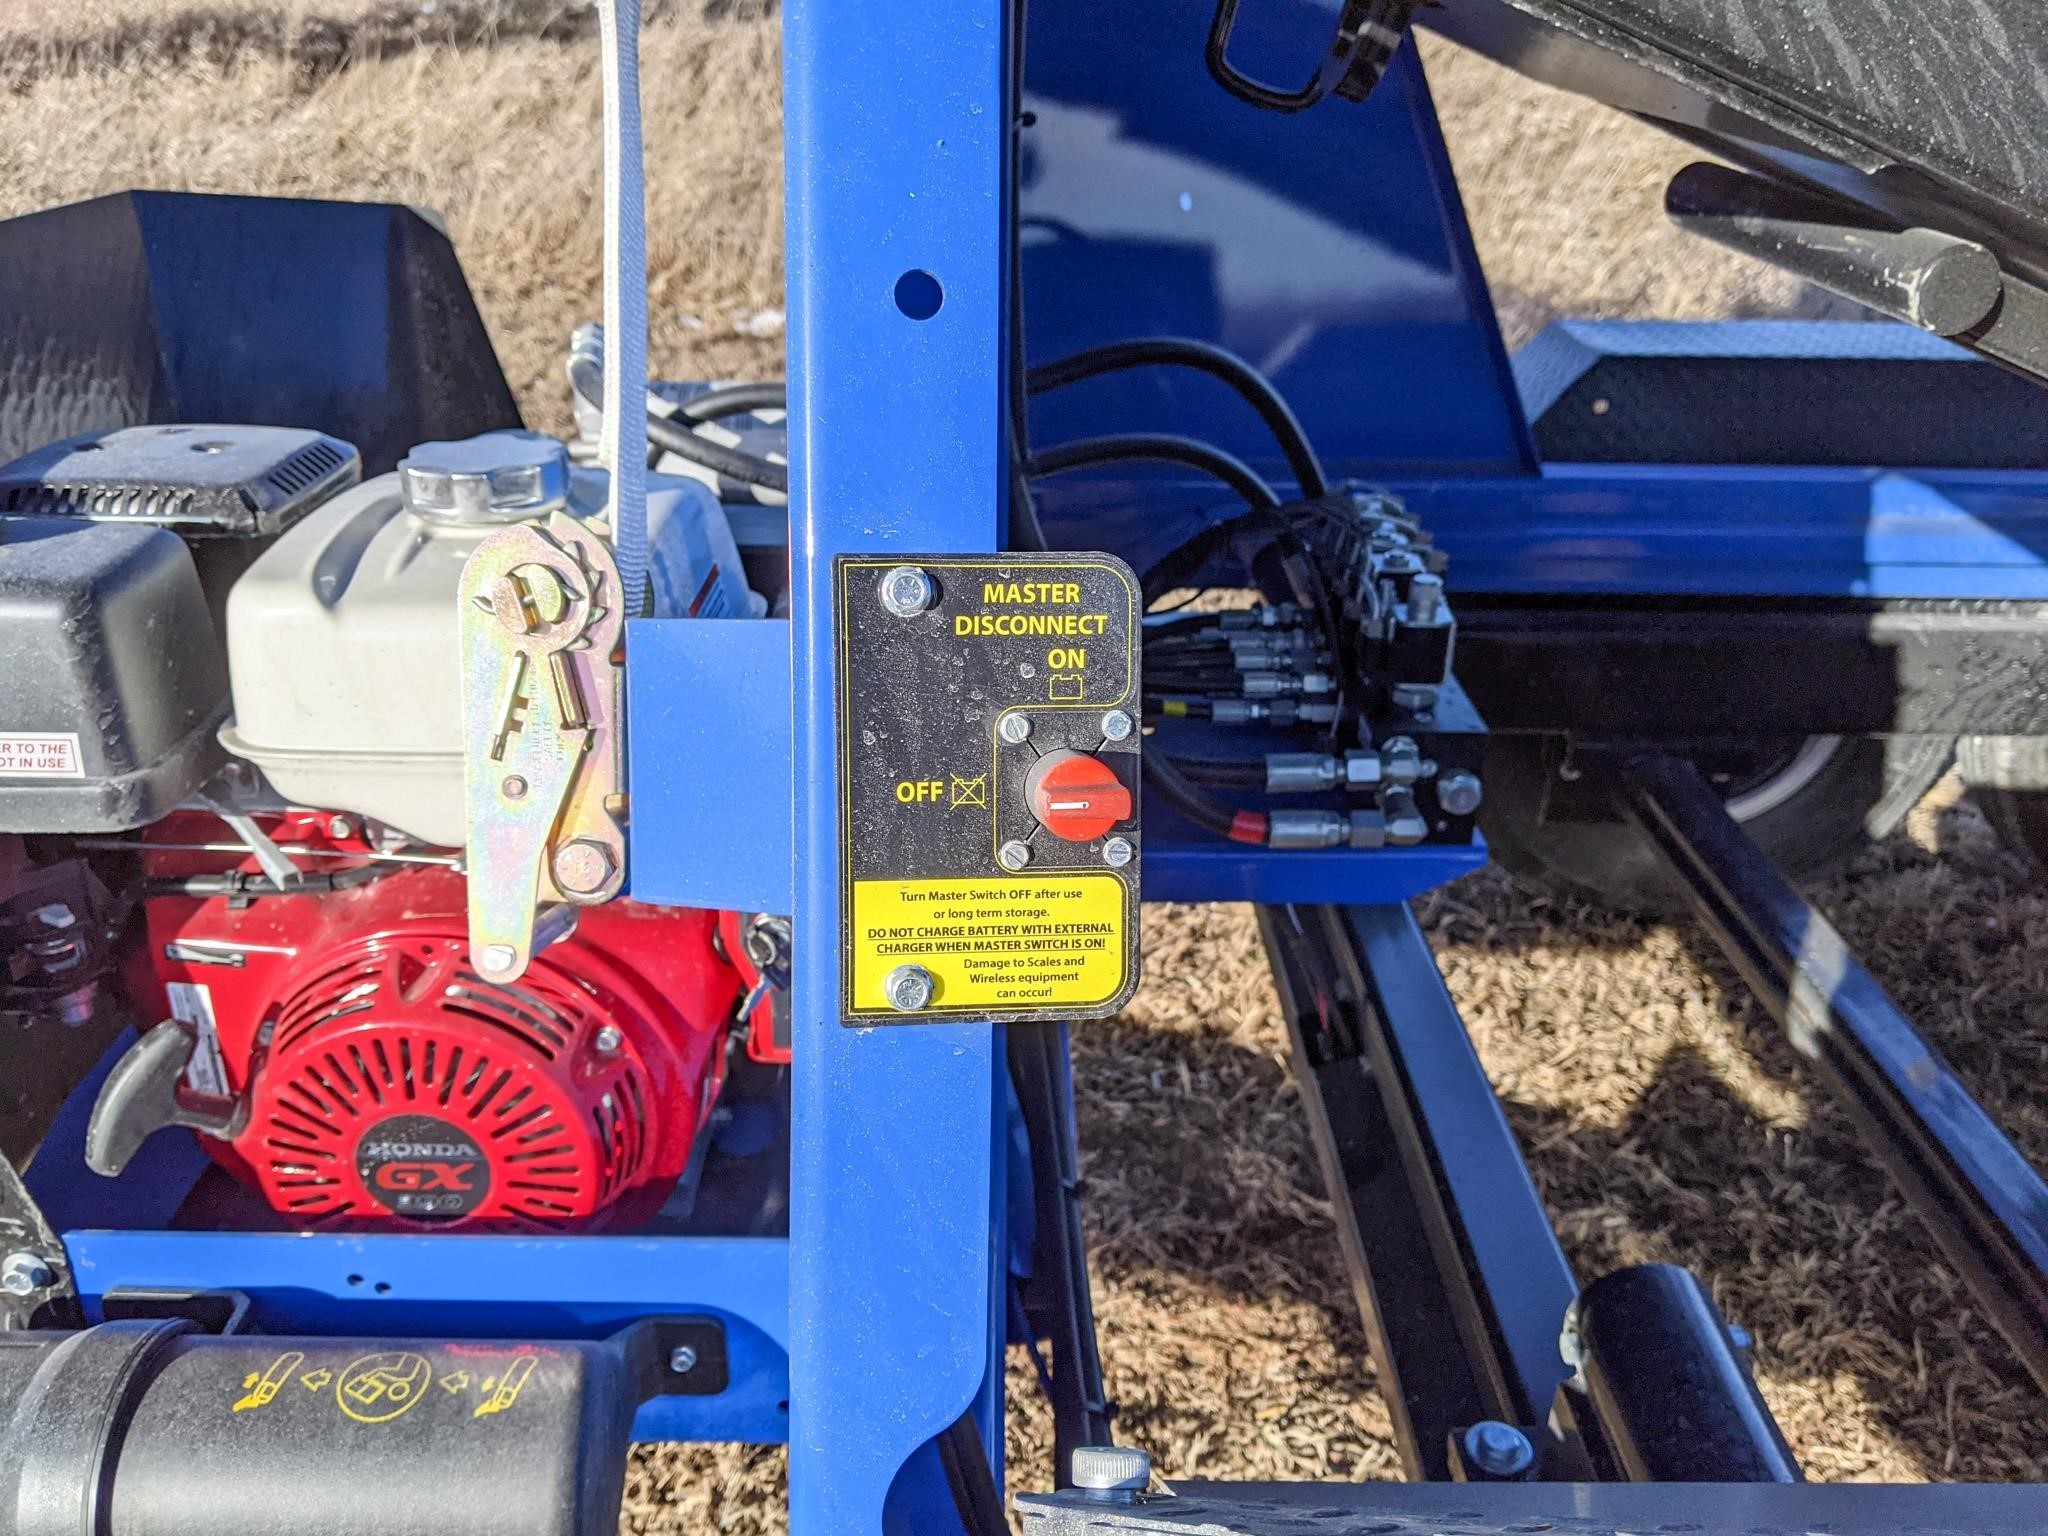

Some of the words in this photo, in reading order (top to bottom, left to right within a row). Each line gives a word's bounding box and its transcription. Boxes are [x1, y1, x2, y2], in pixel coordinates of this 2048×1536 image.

[983, 583, 1080, 604] MASTER
[955, 614, 1108, 636] DISCONNECT
[1048, 648, 1086, 670] ON
[16, 743, 35, 754] TO
[40, 743, 67, 754] THE
[20, 757, 33, 768] IN
[37, 758, 65, 768] USE
[896, 781, 944, 803] OFF
[900, 891, 926, 902] Turn
[928, 890, 967, 901] Master
[969, 889, 1006, 900] Switch
[1009, 889, 1032, 899] OFF
[1034, 888, 1061, 899] after
[1063, 890, 1083, 898] use
[933, 910, 945, 919] or
[948, 908, 973, 920] long
[976, 908, 1003, 918] term
[1005, 908, 1050, 919] storage.
[867, 928, 886, 938] DO
[889, 927, 914, 938] NOT
[917, 926, 965, 937] CHARGE
[967, 925, 1019, 936] BATTERY
[1021, 924, 1052, 934] WITH
[1054, 923, 1114, 934] EXTERNAL
[876, 942, 933, 953] CHARGER
[935, 941, 971, 952] WHEN
[973, 940, 1022, 951] MASTER
[1024, 939, 1069, 949] SWITCH
[1071, 939, 1082, 949] IS
[1084, 938, 1106, 948] ON!
[963, 958, 1011, 970] Damage
[1013, 958, 1025, 968] to
[1027, 957, 1062, 967] Scales
[1063, 956, 1085, 966] and
[969, 973, 1016, 984] Wireless
[1018, 972, 1080, 984] equipment
[996, 989, 1016, 998] can
[1018, 987, 1053, 998] occur!
[364, 1142, 478, 1157] HONDA
[375, 1162, 476, 1191] GX
